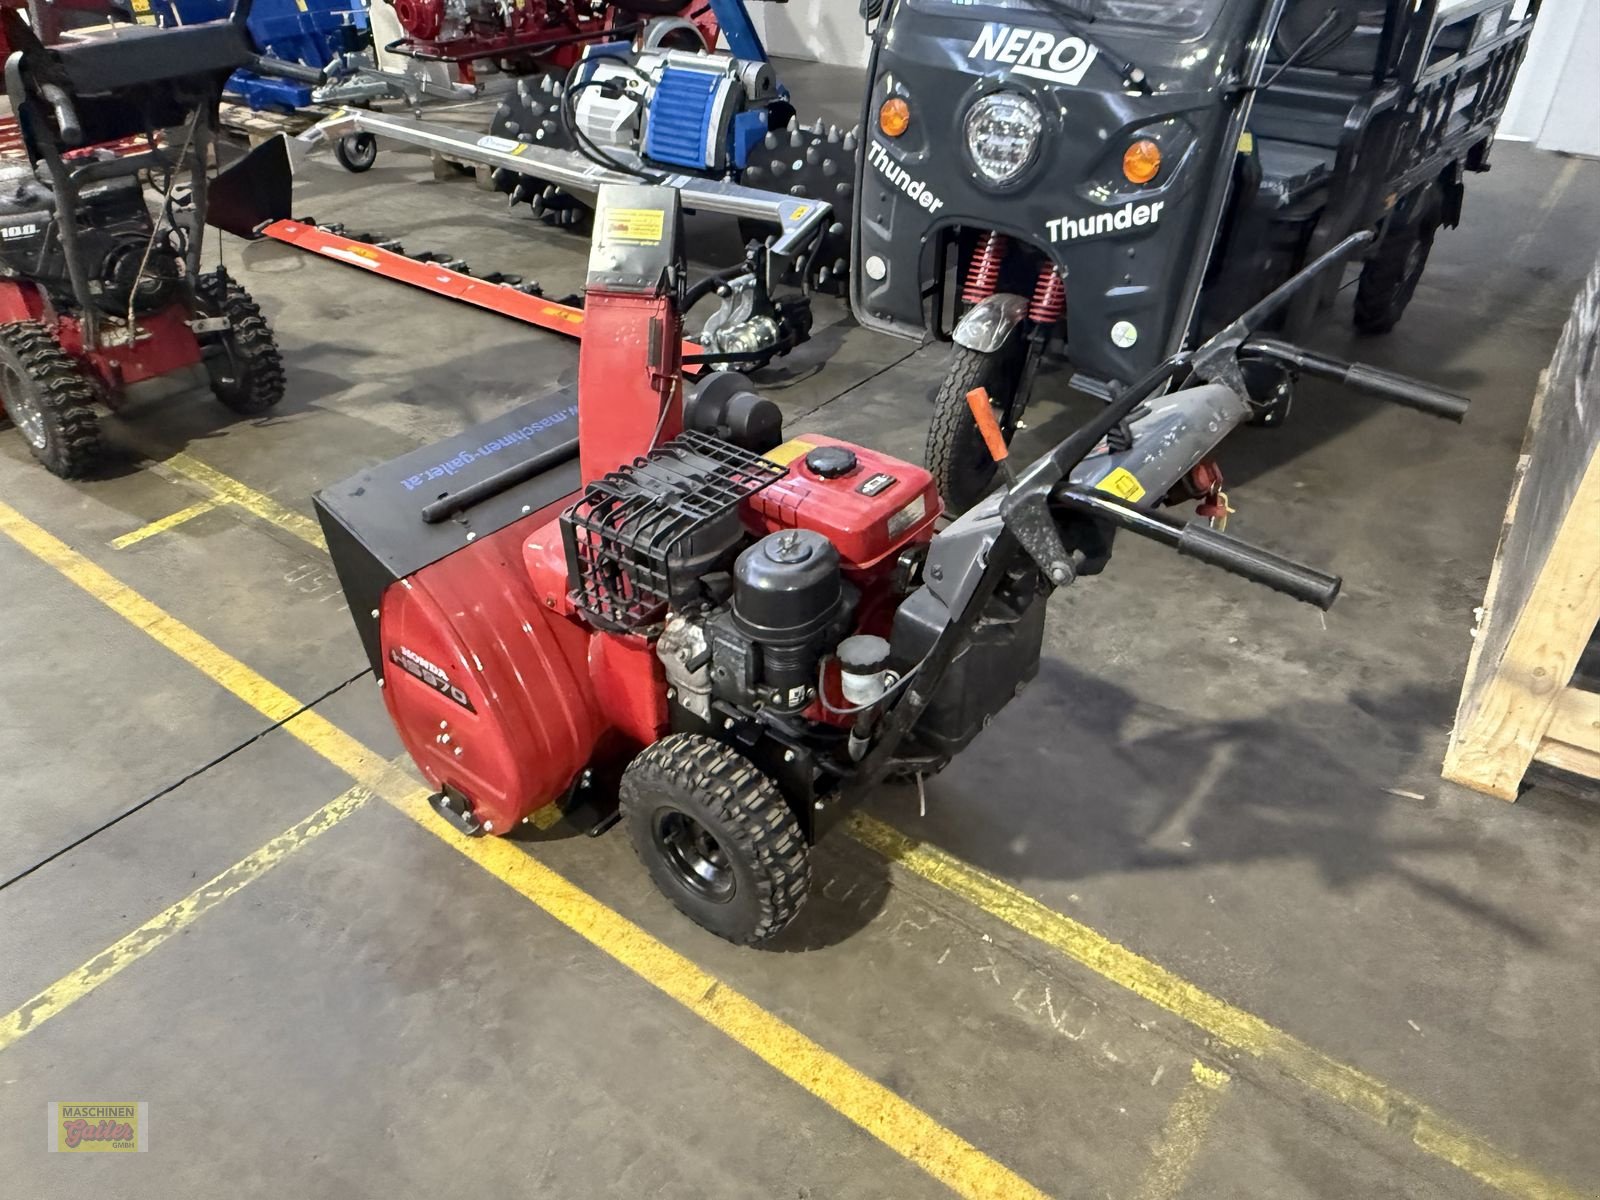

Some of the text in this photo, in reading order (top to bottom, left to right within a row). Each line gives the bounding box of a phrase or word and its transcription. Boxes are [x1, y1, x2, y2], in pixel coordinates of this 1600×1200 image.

[968, 26, 1091, 74] NERO
[867, 139, 944, 214] Thunder
[1045, 199, 1164, 243] Thunder
